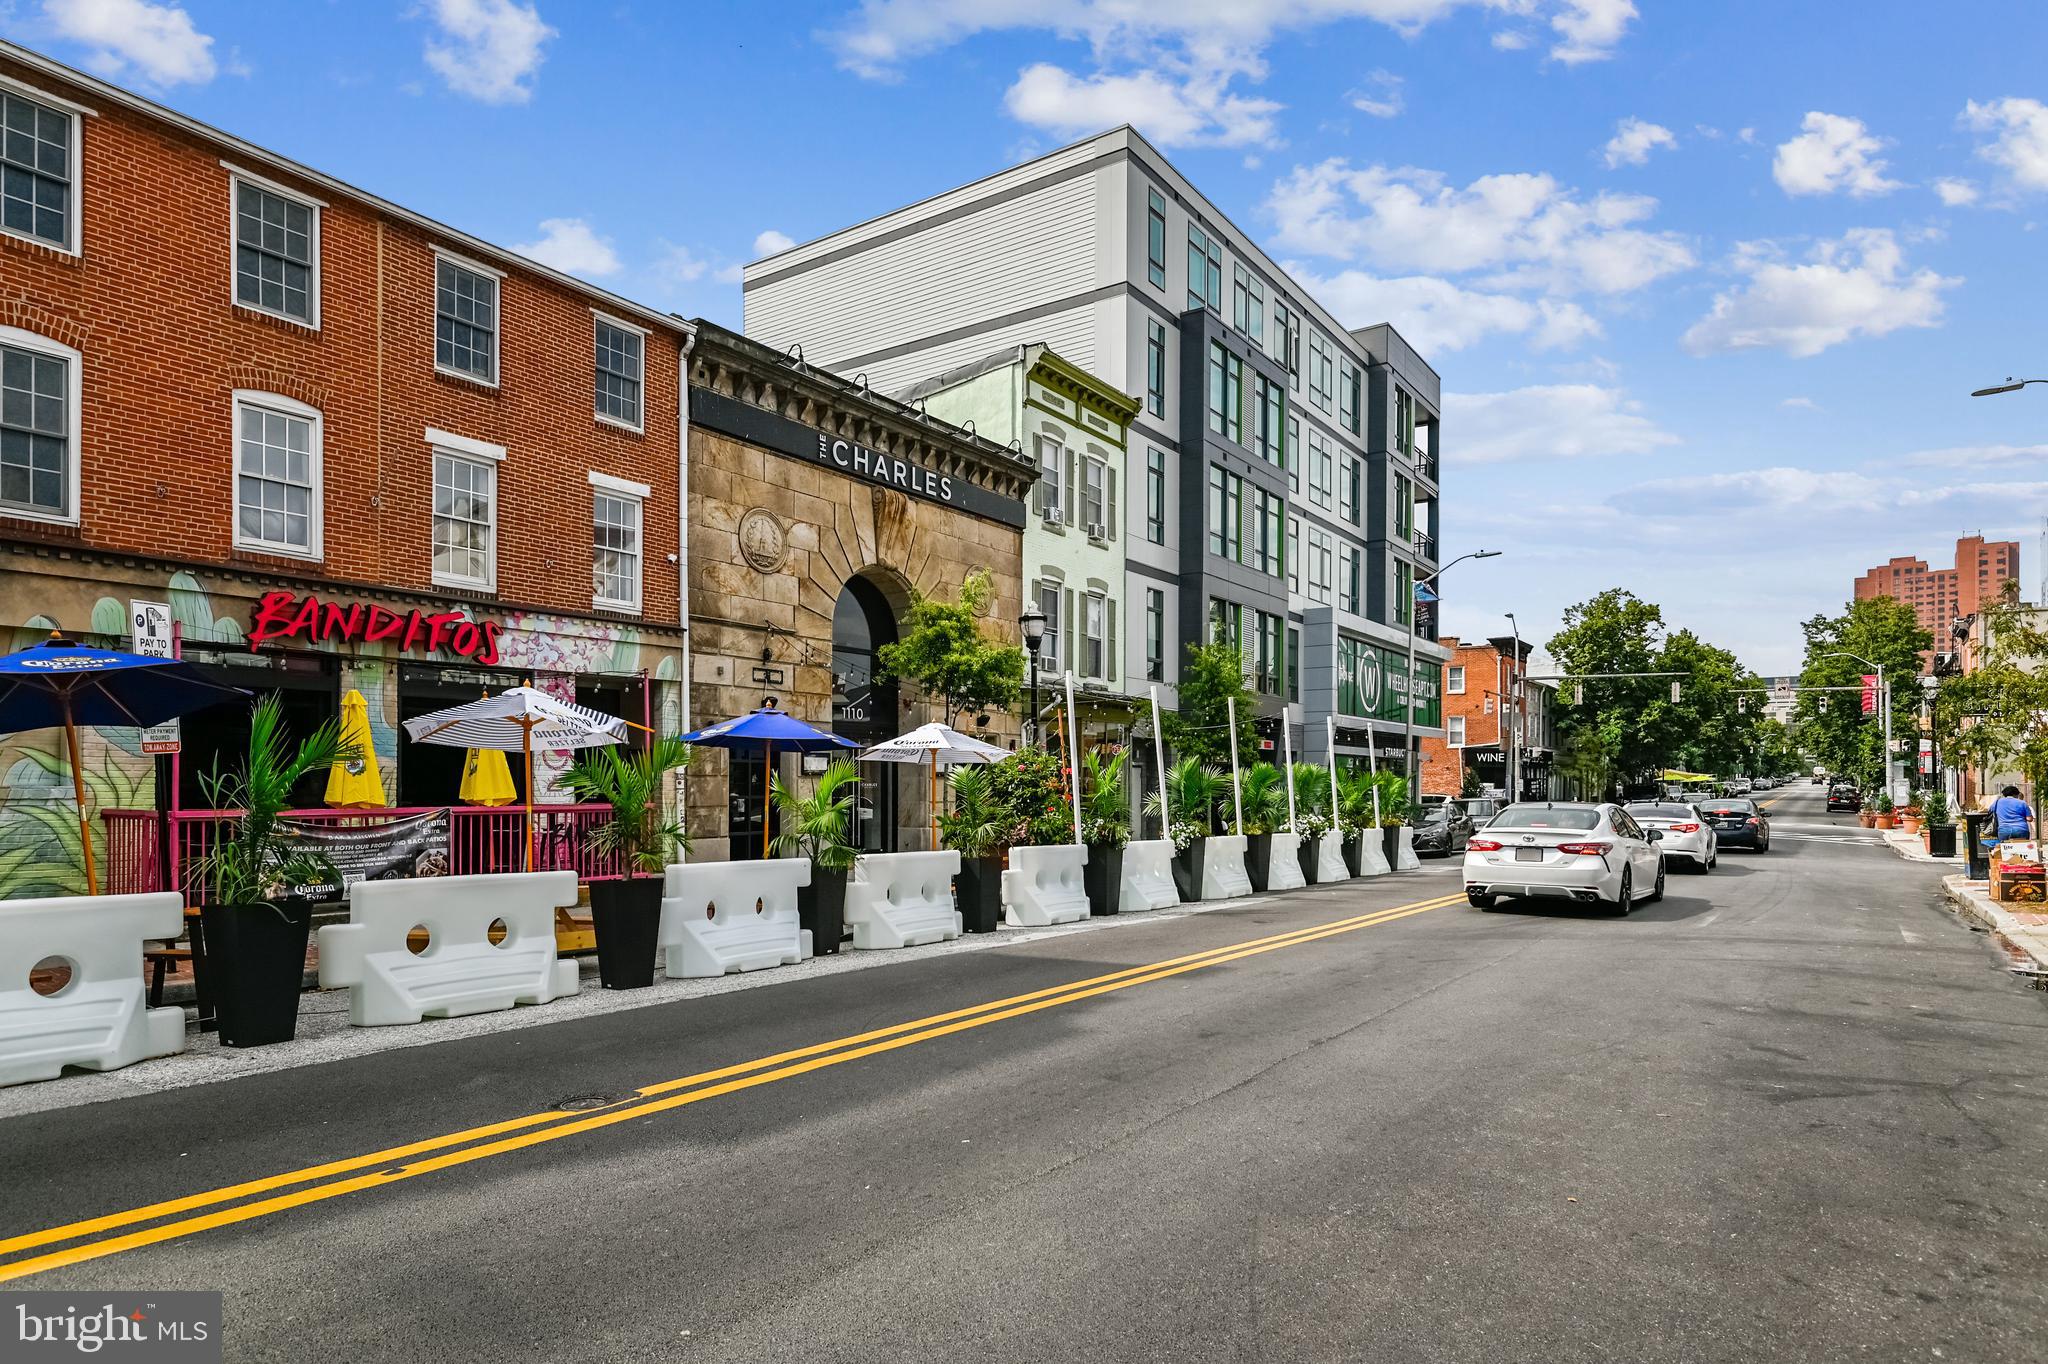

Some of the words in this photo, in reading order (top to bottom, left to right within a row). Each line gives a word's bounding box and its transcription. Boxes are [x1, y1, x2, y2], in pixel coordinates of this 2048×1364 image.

[819, 433, 827, 459] THE
[832, 440, 952, 501] CHARLES
[246, 591, 504, 665] BANDITOS
[140, 637, 155, 648] PAY
[157, 639, 167, 649] TO
[21, 657, 120, 668] Corona
[1364, 665, 1376, 699] W
[841, 707, 864, 720] 1110
[1476, 752, 1505, 763] WINE
[371, 841, 391, 849] FRONT
[392, 839, 406, 847] AND
[294, 883, 335, 896] Corona
